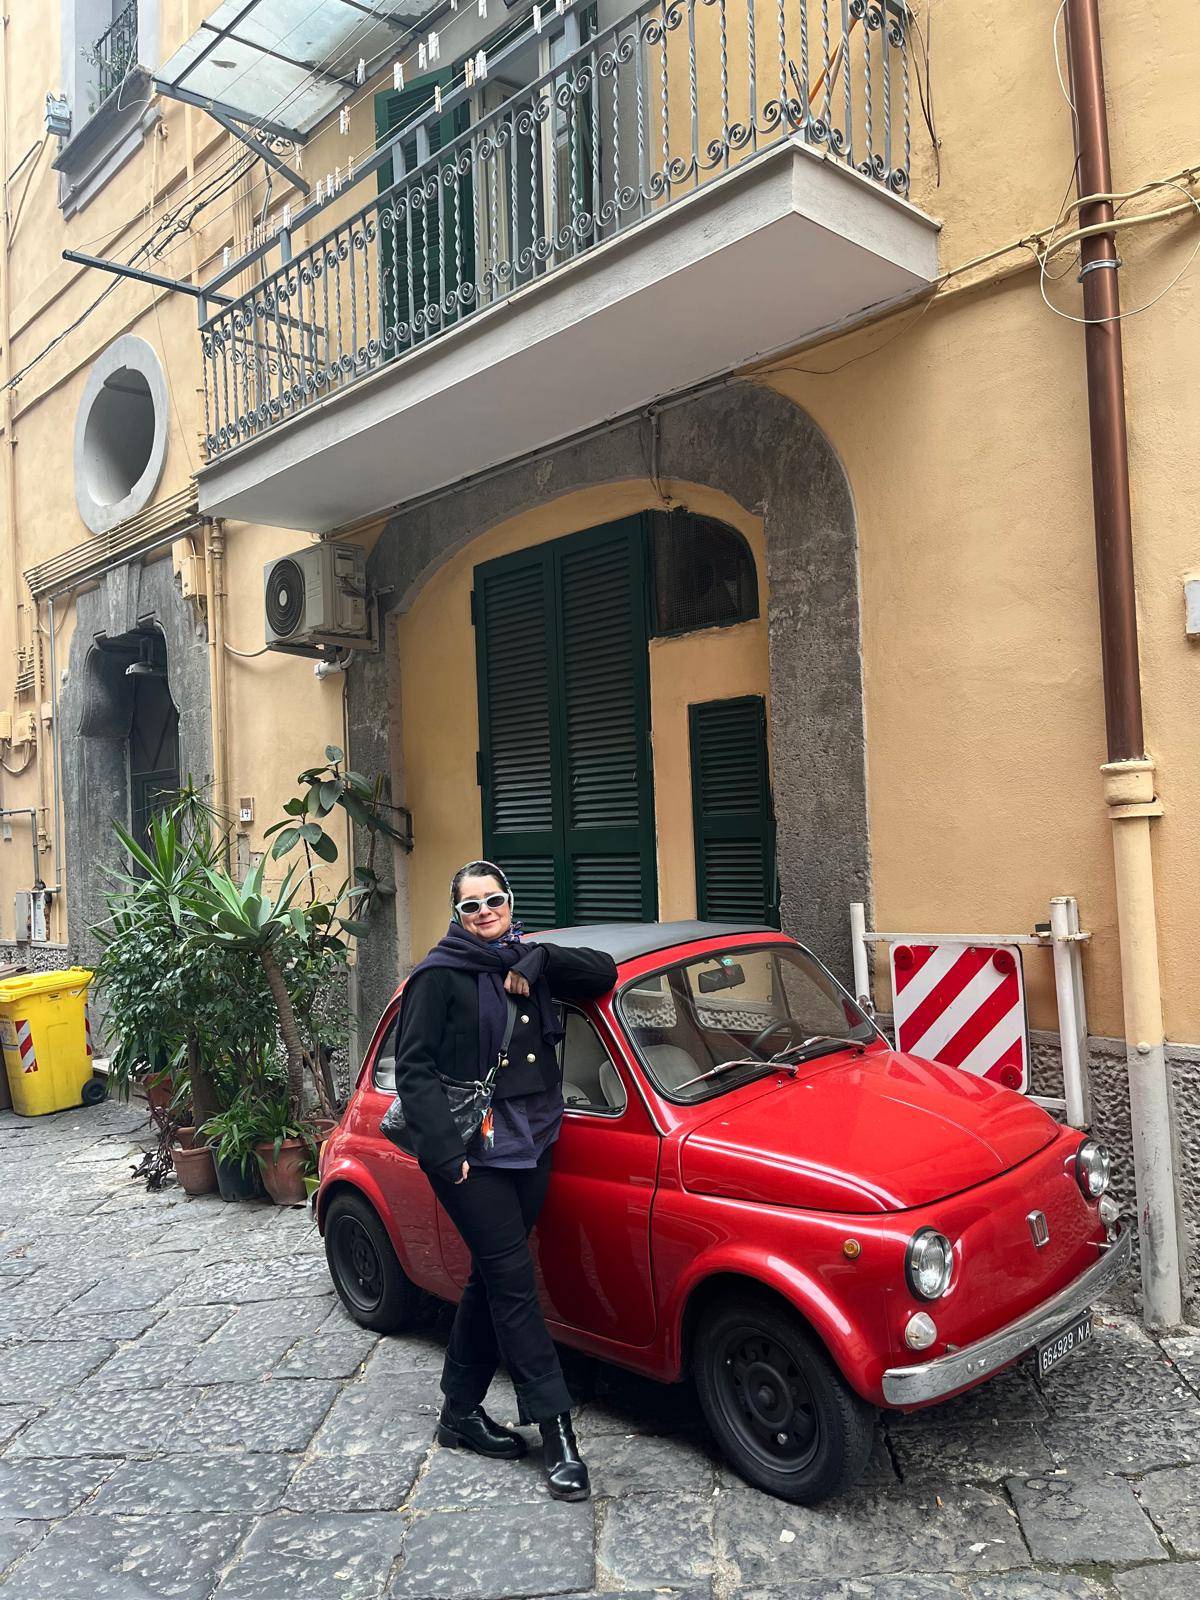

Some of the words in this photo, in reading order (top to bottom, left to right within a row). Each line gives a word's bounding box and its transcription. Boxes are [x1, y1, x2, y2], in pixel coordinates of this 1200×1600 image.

[241, 808, 249, 818] 14
[1043, 1332, 1074, 1370] 664929
[1078, 1321, 1091, 1343] NA
